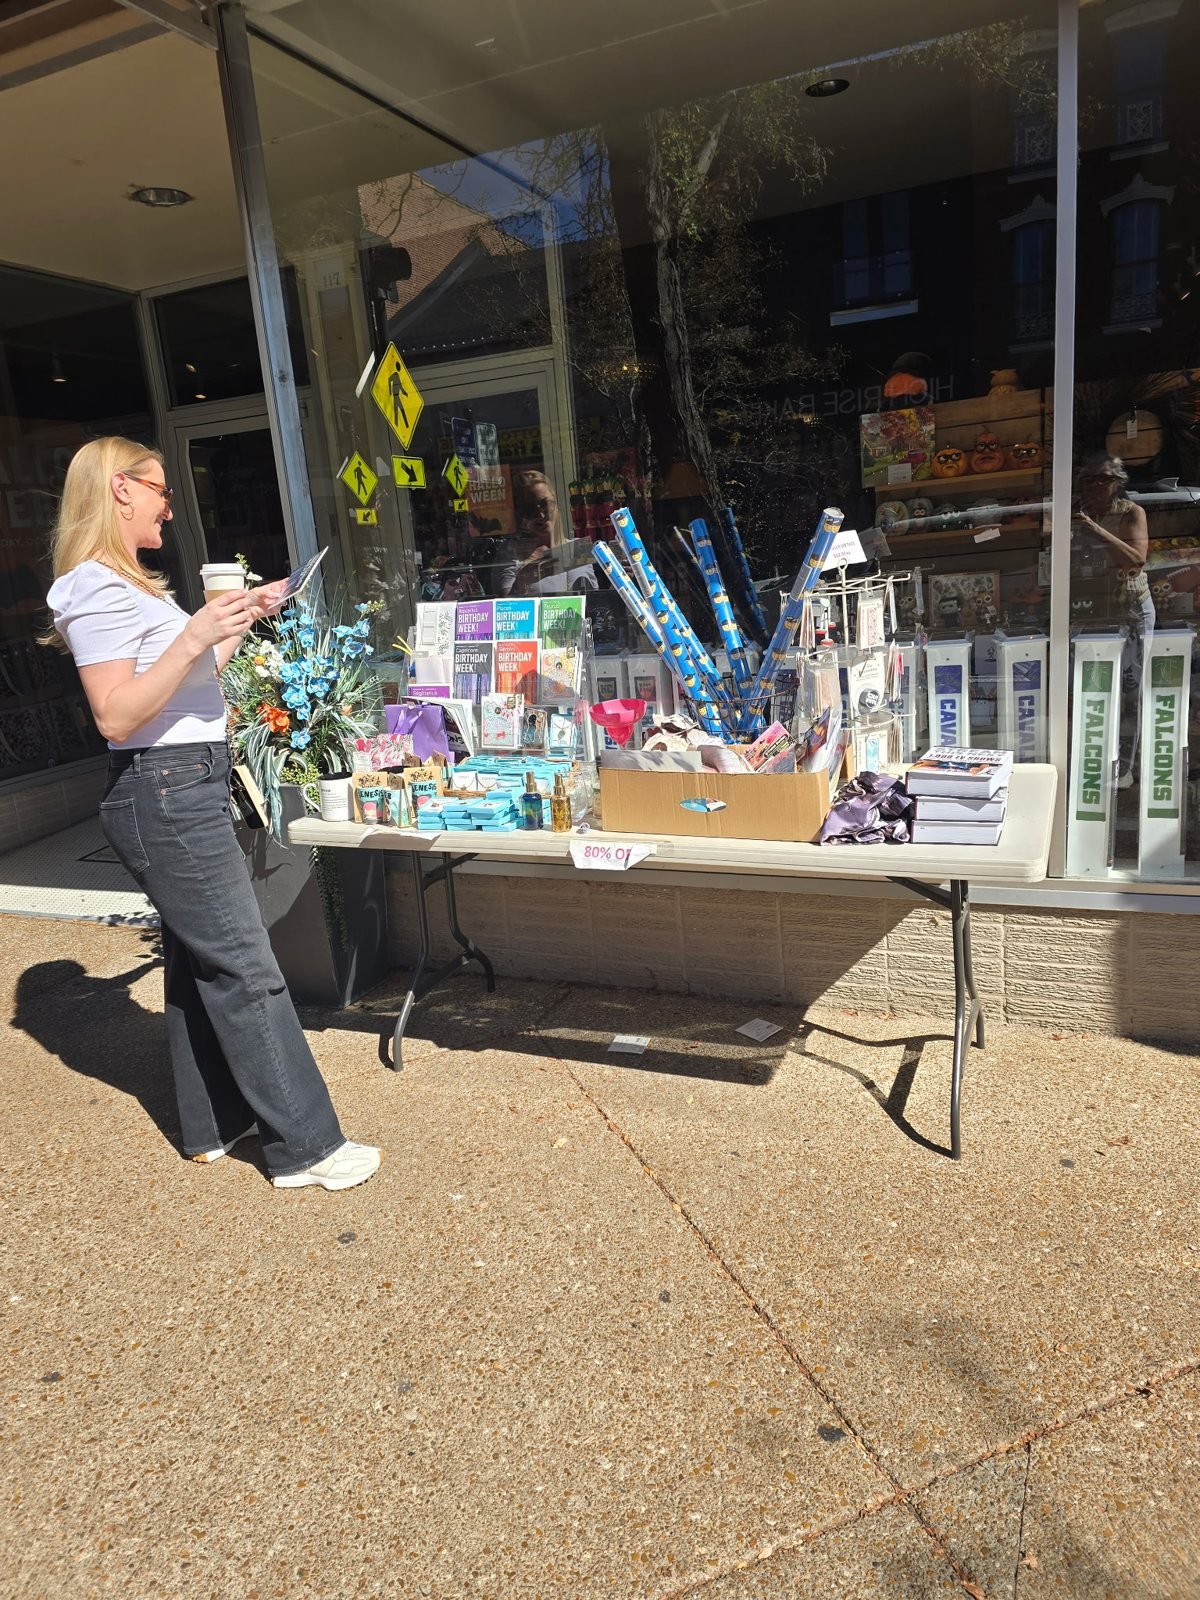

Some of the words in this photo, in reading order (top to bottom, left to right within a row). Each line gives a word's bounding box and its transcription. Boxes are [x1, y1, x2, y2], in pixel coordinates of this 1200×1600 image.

[323, 271, 340, 287] 117
[470, 488, 506, 503] WEEN
[458, 613, 489, 624] BIRTHDAY
[496, 610, 530, 621] BIRTHDAY
[543, 608, 577, 620] BIRTHDAY
[457, 622, 479, 633] WEEK!
[496, 621, 519, 631] WEEK!
[543, 618, 566, 629] WEEK!
[455, 652, 488, 663] BIRTHDAY
[498, 651, 533, 662] BIRTHDAY
[455, 662, 477, 673] WEEK!
[498, 661, 521, 672] WEEK!
[1082, 699, 1105, 805] FALCONS
[1153, 694, 1175, 801] FALCONS
[584, 846, 612, 859] 80%
